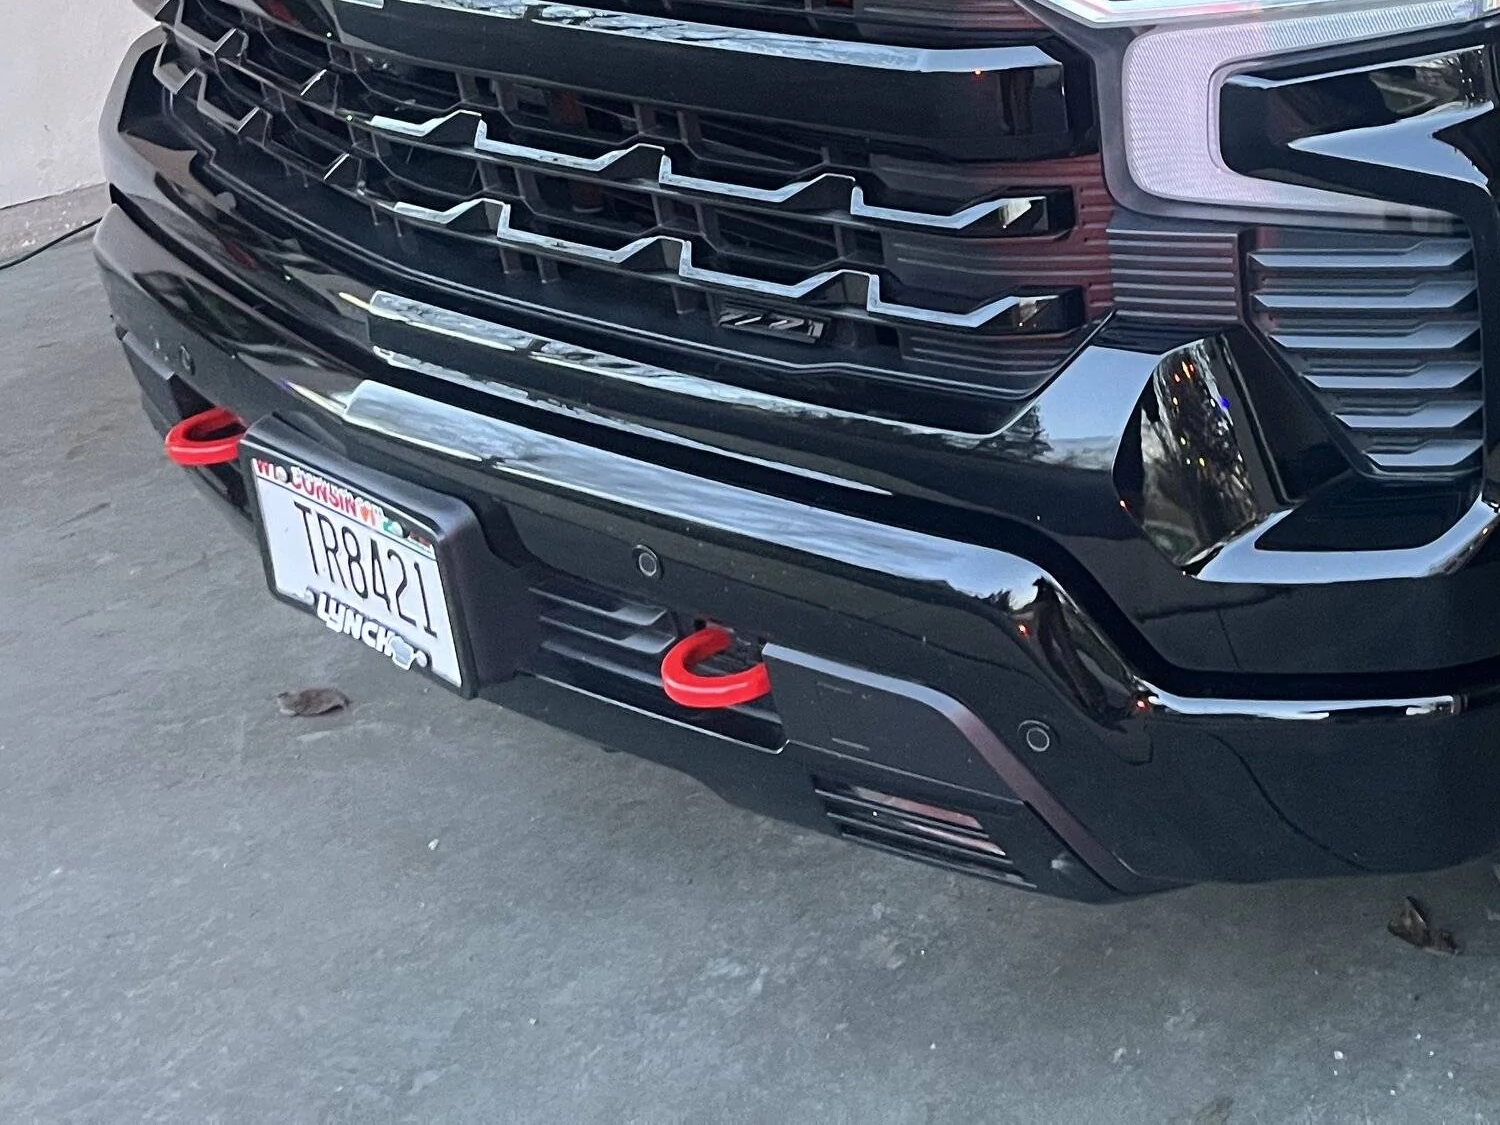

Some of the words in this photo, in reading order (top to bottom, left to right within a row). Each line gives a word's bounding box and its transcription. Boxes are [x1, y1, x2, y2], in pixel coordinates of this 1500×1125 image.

[718, 306, 825, 343] Z71
[255, 458, 357, 517] WICONSIN
[293, 500, 438, 639] TR8421
[316, 592, 397, 657] LYNCH
